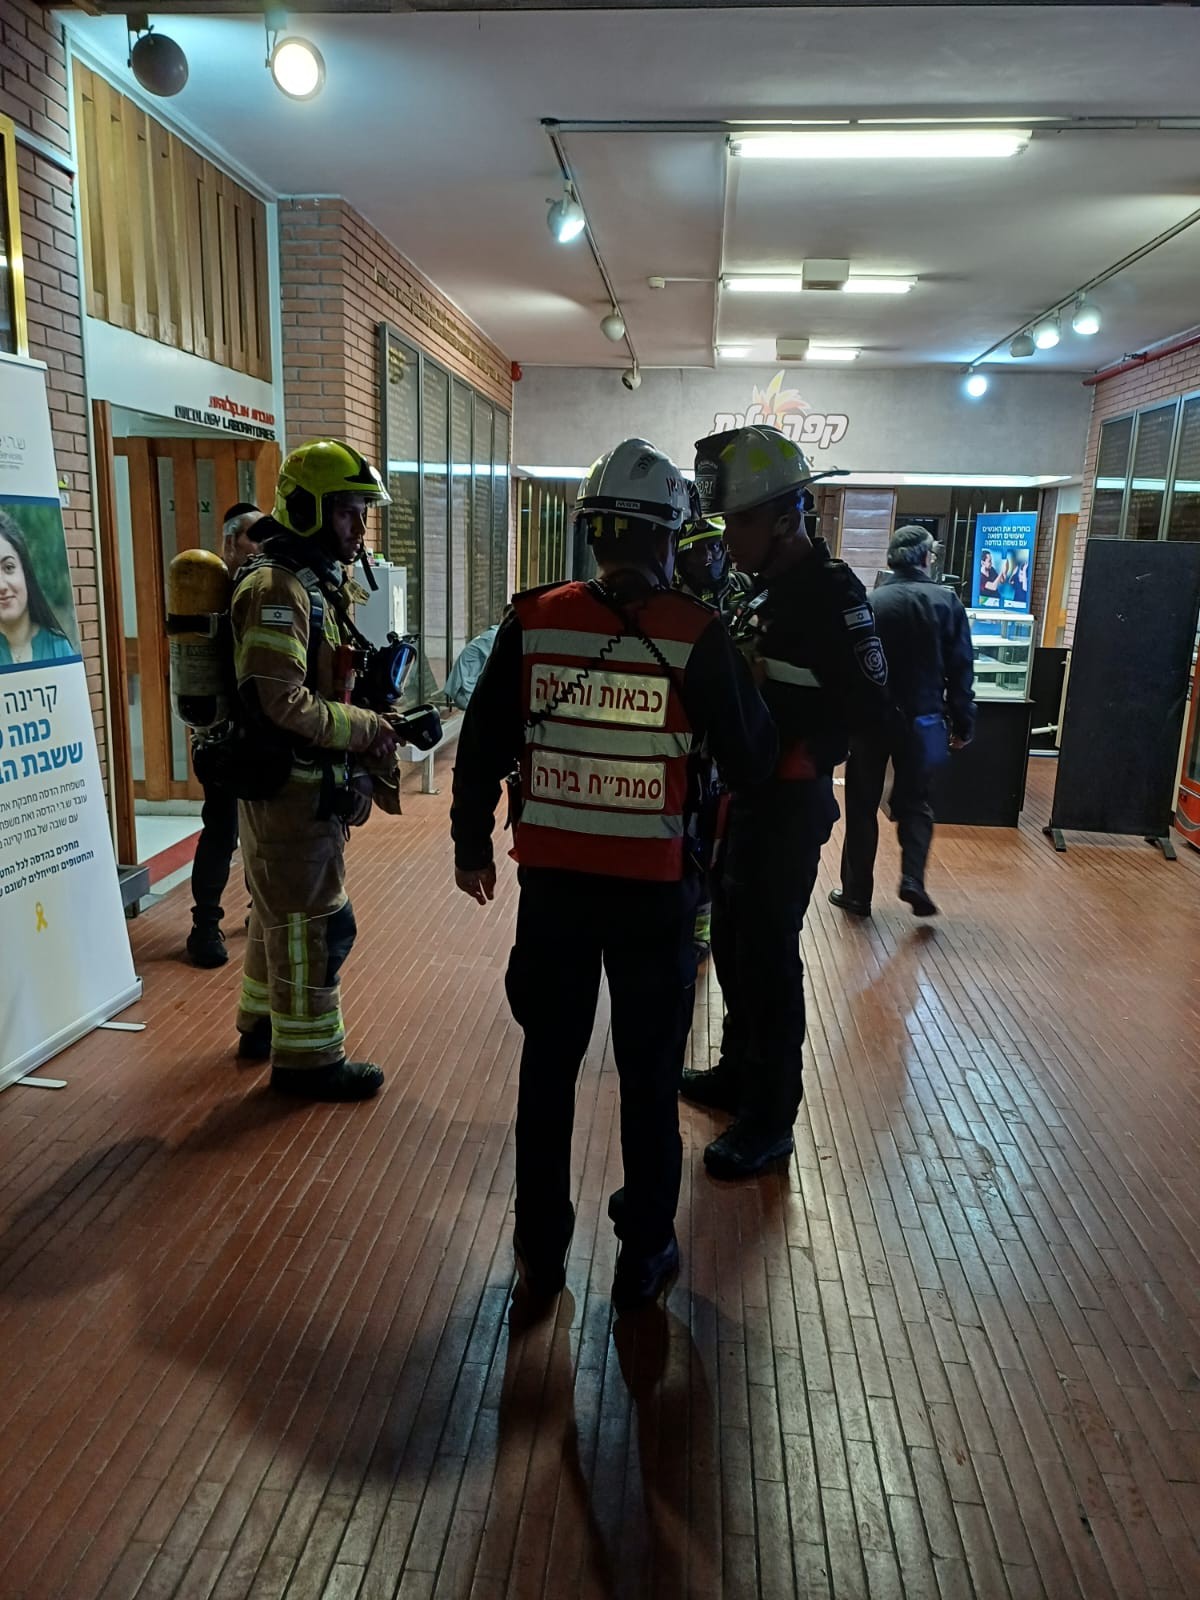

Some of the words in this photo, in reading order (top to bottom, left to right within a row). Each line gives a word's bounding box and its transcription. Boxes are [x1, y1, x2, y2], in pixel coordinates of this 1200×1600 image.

[174, 404, 221, 428] ONCOLOGY
[222, 416, 276, 441] LABORATORIES
[782, 413, 850, 449] קפה
[4, 685, 57, 714] קרינה
[598, 686, 663, 713] כבאות
[8, 718, 51, 747] כמה
[21, 741, 83, 777] ששבת
[60, 779, 86, 794] משפחת
[536, 766, 580, 793] בירה
[12, 793, 38, 809] מחבקת
[39, 786, 59, 800] הדסה
[73, 794, 88, 805] עובד
[0, 801, 11, 813] את
[36, 805, 56, 818] הדסה
[21, 811, 35, 823] ואת
[49, 817, 67, 830] שובה
[68, 813, 78, 823] עם
[24, 828, 37, 839] בתו
[37, 824, 48, 834] של
[3, 832, 22, 848] קרינה
[56, 840, 79, 855] מחכים
[16, 857, 28, 871] לכל
[30, 849, 55, 866] בהדסה
[60, 850, 94, 870] והחטופים
[28, 864, 60, 883] ומייחלים
[4, 876, 27, 894] לשובם
